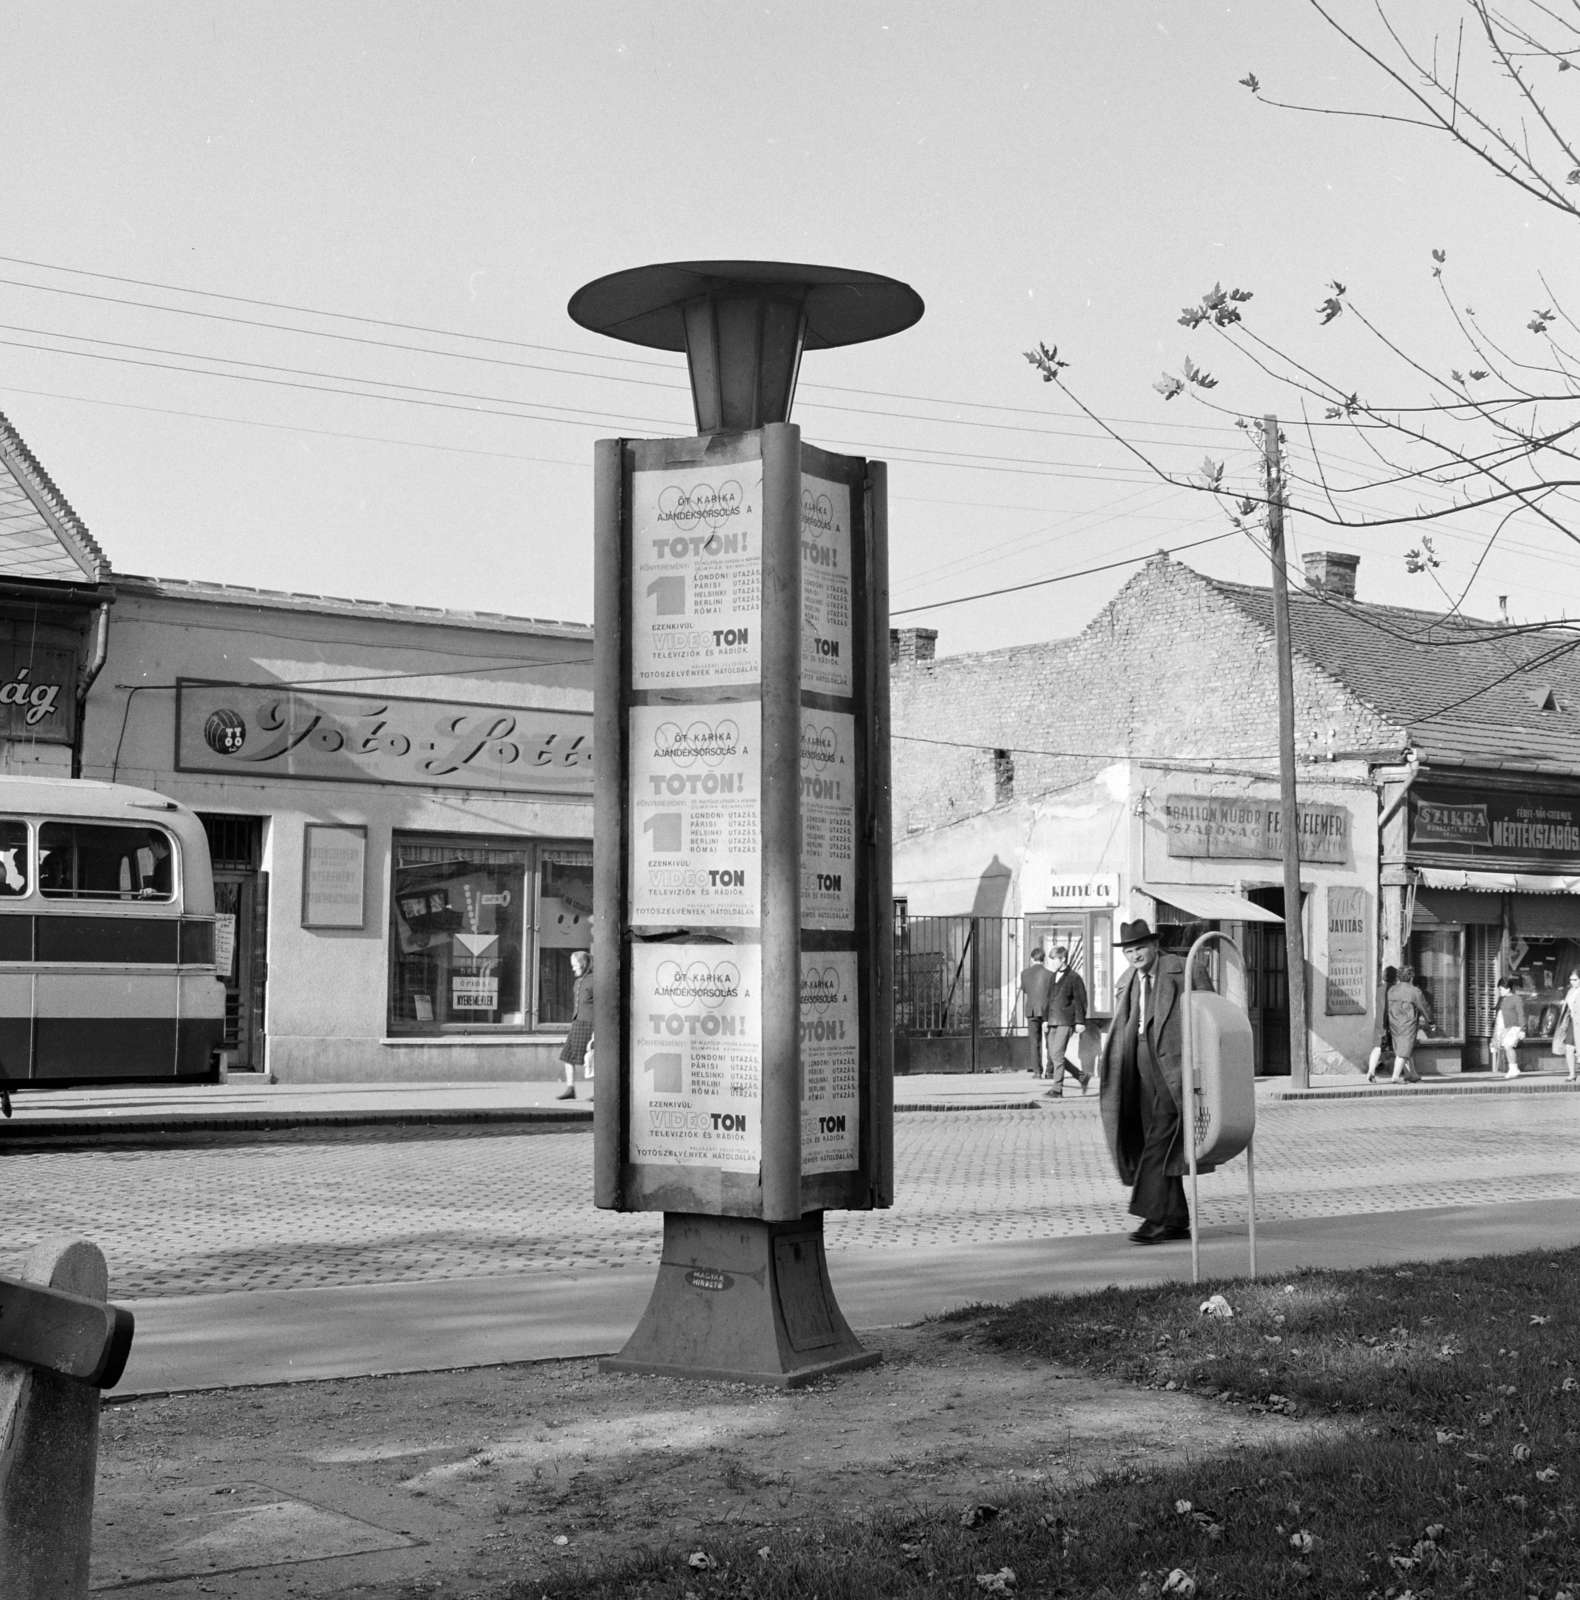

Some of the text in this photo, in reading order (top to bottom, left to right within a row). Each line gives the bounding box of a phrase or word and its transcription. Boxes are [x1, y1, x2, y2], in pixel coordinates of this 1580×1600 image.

[697, 493, 735, 504] KARIKA
[657, 505, 752, 521] AJÁNDÉKSORSOLÁS A
[836, 525, 840, 533] A
[694, 573, 728, 581] LONDONI
[647, 576, 685, 616] 1
[694, 590, 726, 598] HELSINKI
[653, 628, 748, 650] VIDEOTON
[653, 651, 700, 659] TELEVIZIÓK
[640, 669, 710, 678] TOTÓSZELVÉNYEK
[694, 733, 731, 742] KARIKA
[654, 746, 748, 757] AJÁNDÉKSORSOLÁS A
[840, 756, 845, 764] A
[1420, 808, 1486, 826] SZIKRA
[643, 812, 682, 852] 1
[648, 869, 745, 887] VIDEOTON
[648, 888, 696, 896] TELEVIZIÓK
[701, 888, 710, 896] ÉS
[636, 907, 706, 915] TOTÓSZELVÉNYEK
[1329, 916, 1363, 933] JAVITÁS
[693, 974, 731, 983] KARIKA
[654, 986, 750, 998] AJÁNDÉKSORSOLÁS A
[843, 995, 847, 1003] A
[644, 1052, 682, 1093] 1
[691, 1071, 724, 1079] HELSINKI
[650, 1110, 746, 1132] VIDEOTON
[650, 1130, 699, 1139] TELEVIZIÓK
[703, 1131, 712, 1139] ÉS
[637, 1149, 708, 1159] TOTÓSZELVÉNYEK
